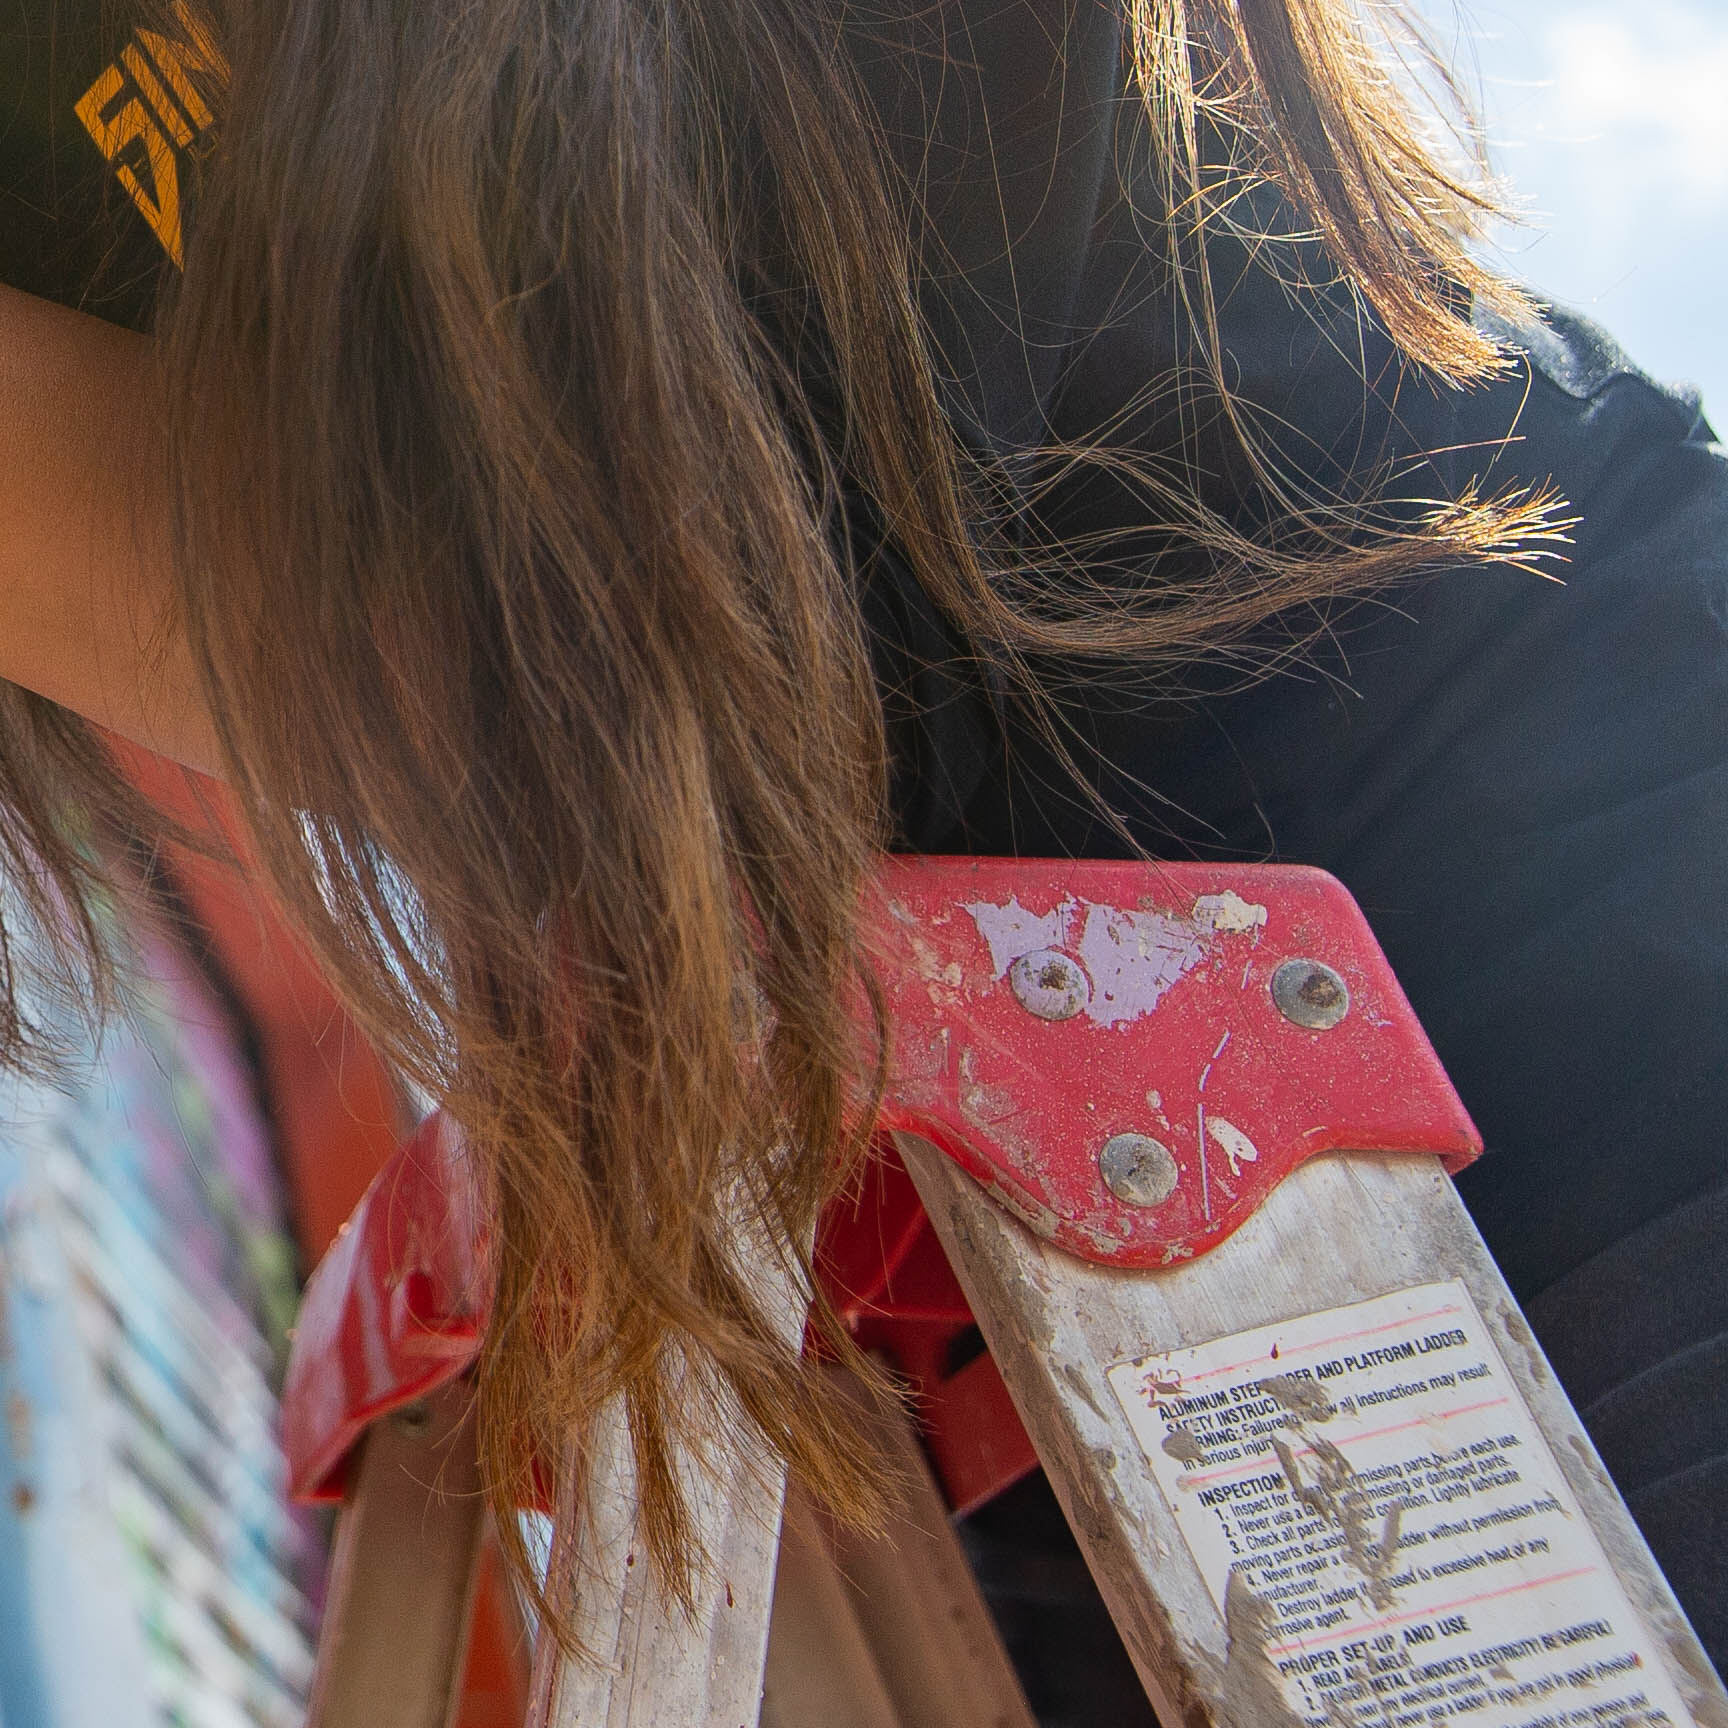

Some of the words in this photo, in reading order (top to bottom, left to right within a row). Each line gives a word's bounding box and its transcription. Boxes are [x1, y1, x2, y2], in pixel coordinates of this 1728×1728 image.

[1158, 1390, 1230, 1421] ALUMINUM
[1229, 1368, 1315, 1402] STEPDER
[1315, 1360, 1344, 1380] AND
[1343, 1341, 1416, 1373] PLATFORM
[1414, 1329, 1468, 1354] LADDER
[1194, 1427, 1243, 1449] RNING:
[1241, 1417, 1286, 1438] Failure
[1428, 1373, 1457, 1390] may
[1457, 1363, 1492, 1382] result
[1215, 1392, 1294, 1427] INSTRUCT
[1213, 1507, 1229, 1521] 1.
[1229, 1496, 1273, 1518] Inspect
[1271, 1493, 1290, 1506] for
[1469, 1437, 1498, 1456] each
[1240, 1436, 1277, 1457] injur
[1197, 1472, 1286, 1508] INSPECTION
[1221, 1523, 1237, 1538] 2.
[1237, 1516, 1271, 1534] Never
[1271, 1511, 1294, 1525] use
[1410, 1476, 1425, 1489] or
[1425, 1460, 1480, 1489] damaged
[1229, 1539, 1244, 1554] 3.
[1245, 1530, 1282, 1550] Check
[1281, 1525, 1297, 1541] all
[1296, 1518, 1327, 1540] parts
[1430, 1479, 1471, 1503] Lightly
[1469, 1469, 1521, 1492] lubricate
[1230, 1553, 1274, 1576] moving
[1272, 1545, 1304, 1565] parts
[1261, 1567, 1294, 1584] Never
[1295, 1555, 1329, 1576] repair
[1391, 1531, 1428, 1549] adder
[1427, 1519, 1473, 1540] without
[1471, 1504, 1535, 1532] permission
[1276, 1598, 1322, 1618] Destroy
[1320, 1587, 1359, 1606] ladder
[1432, 1555, 1487, 1578] excessive
[1484, 1545, 1516, 1564] heat
[1526, 1538, 1550, 1554] any
[1257, 1573, 1324, 1604] nufacturer.
[1278, 1650, 1341, 1679] PROPER
[1403, 1624, 1435, 1647] AND
[1436, 1615, 1471, 1637] USE
[1311, 1669, 1343, 1690] READ
